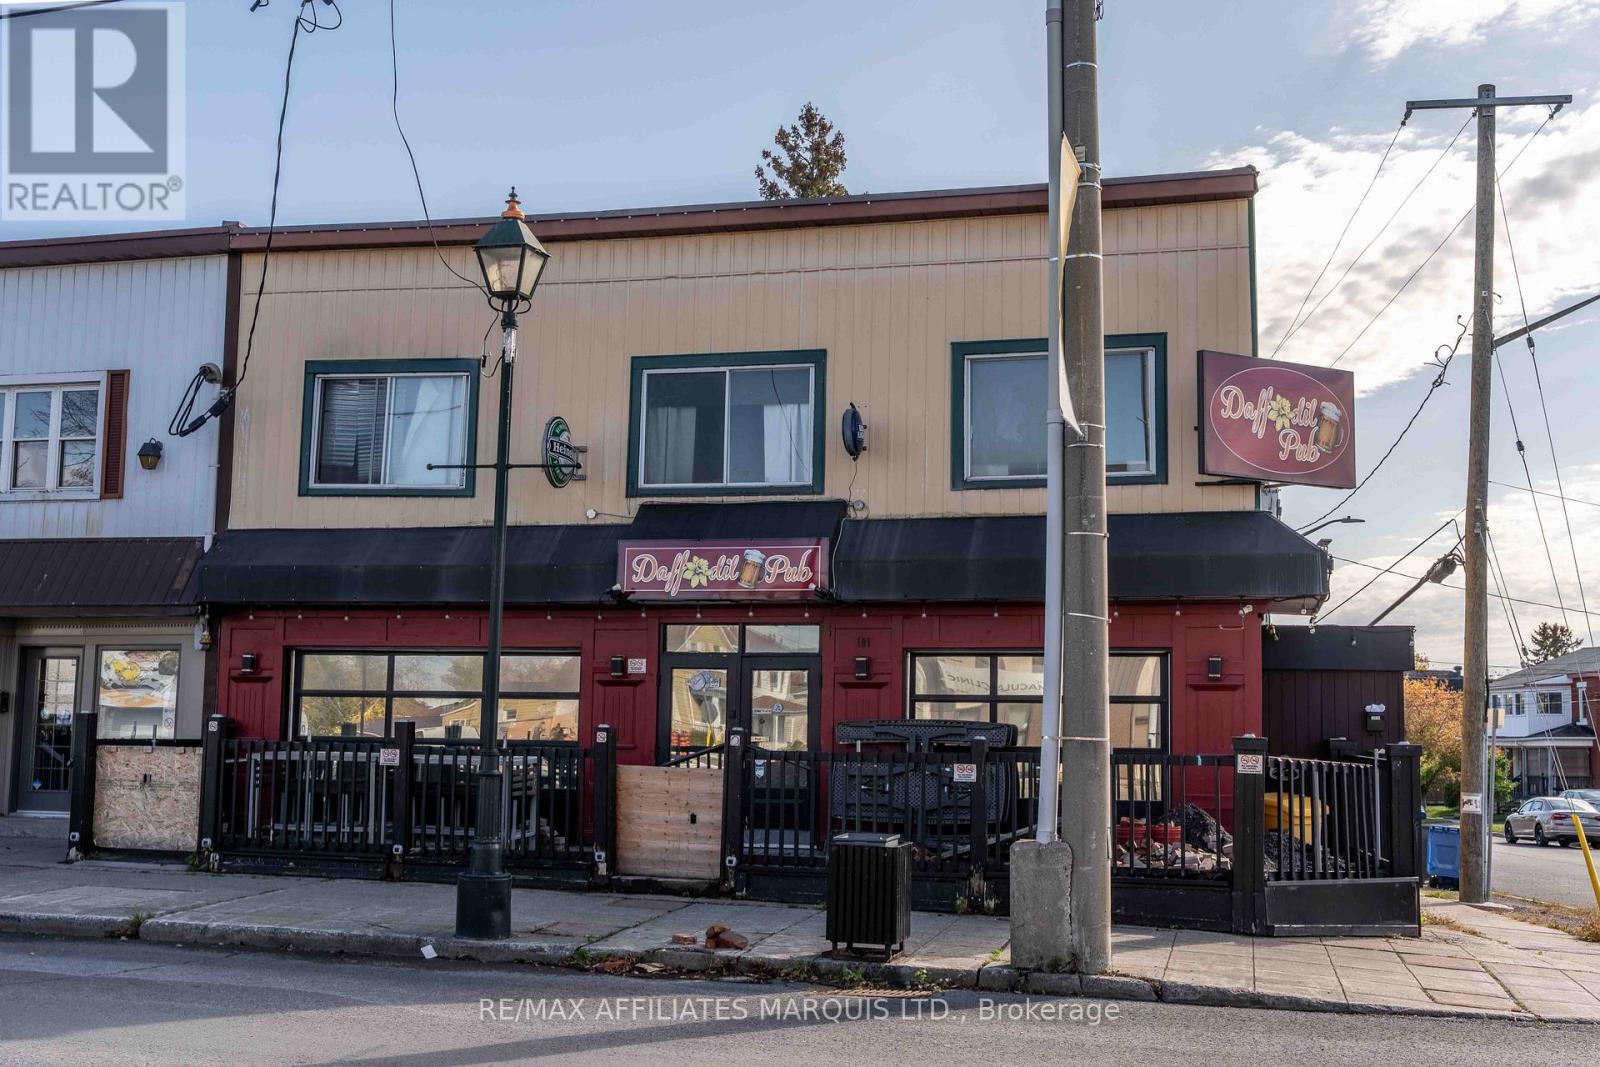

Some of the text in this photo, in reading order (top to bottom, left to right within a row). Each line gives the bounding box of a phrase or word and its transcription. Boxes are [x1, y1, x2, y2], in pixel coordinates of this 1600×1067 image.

[1220, 385, 1318, 439] Daffdil
[1278, 426, 1321, 463] Pub
[632, 548, 813, 597] Daffdil Pub
